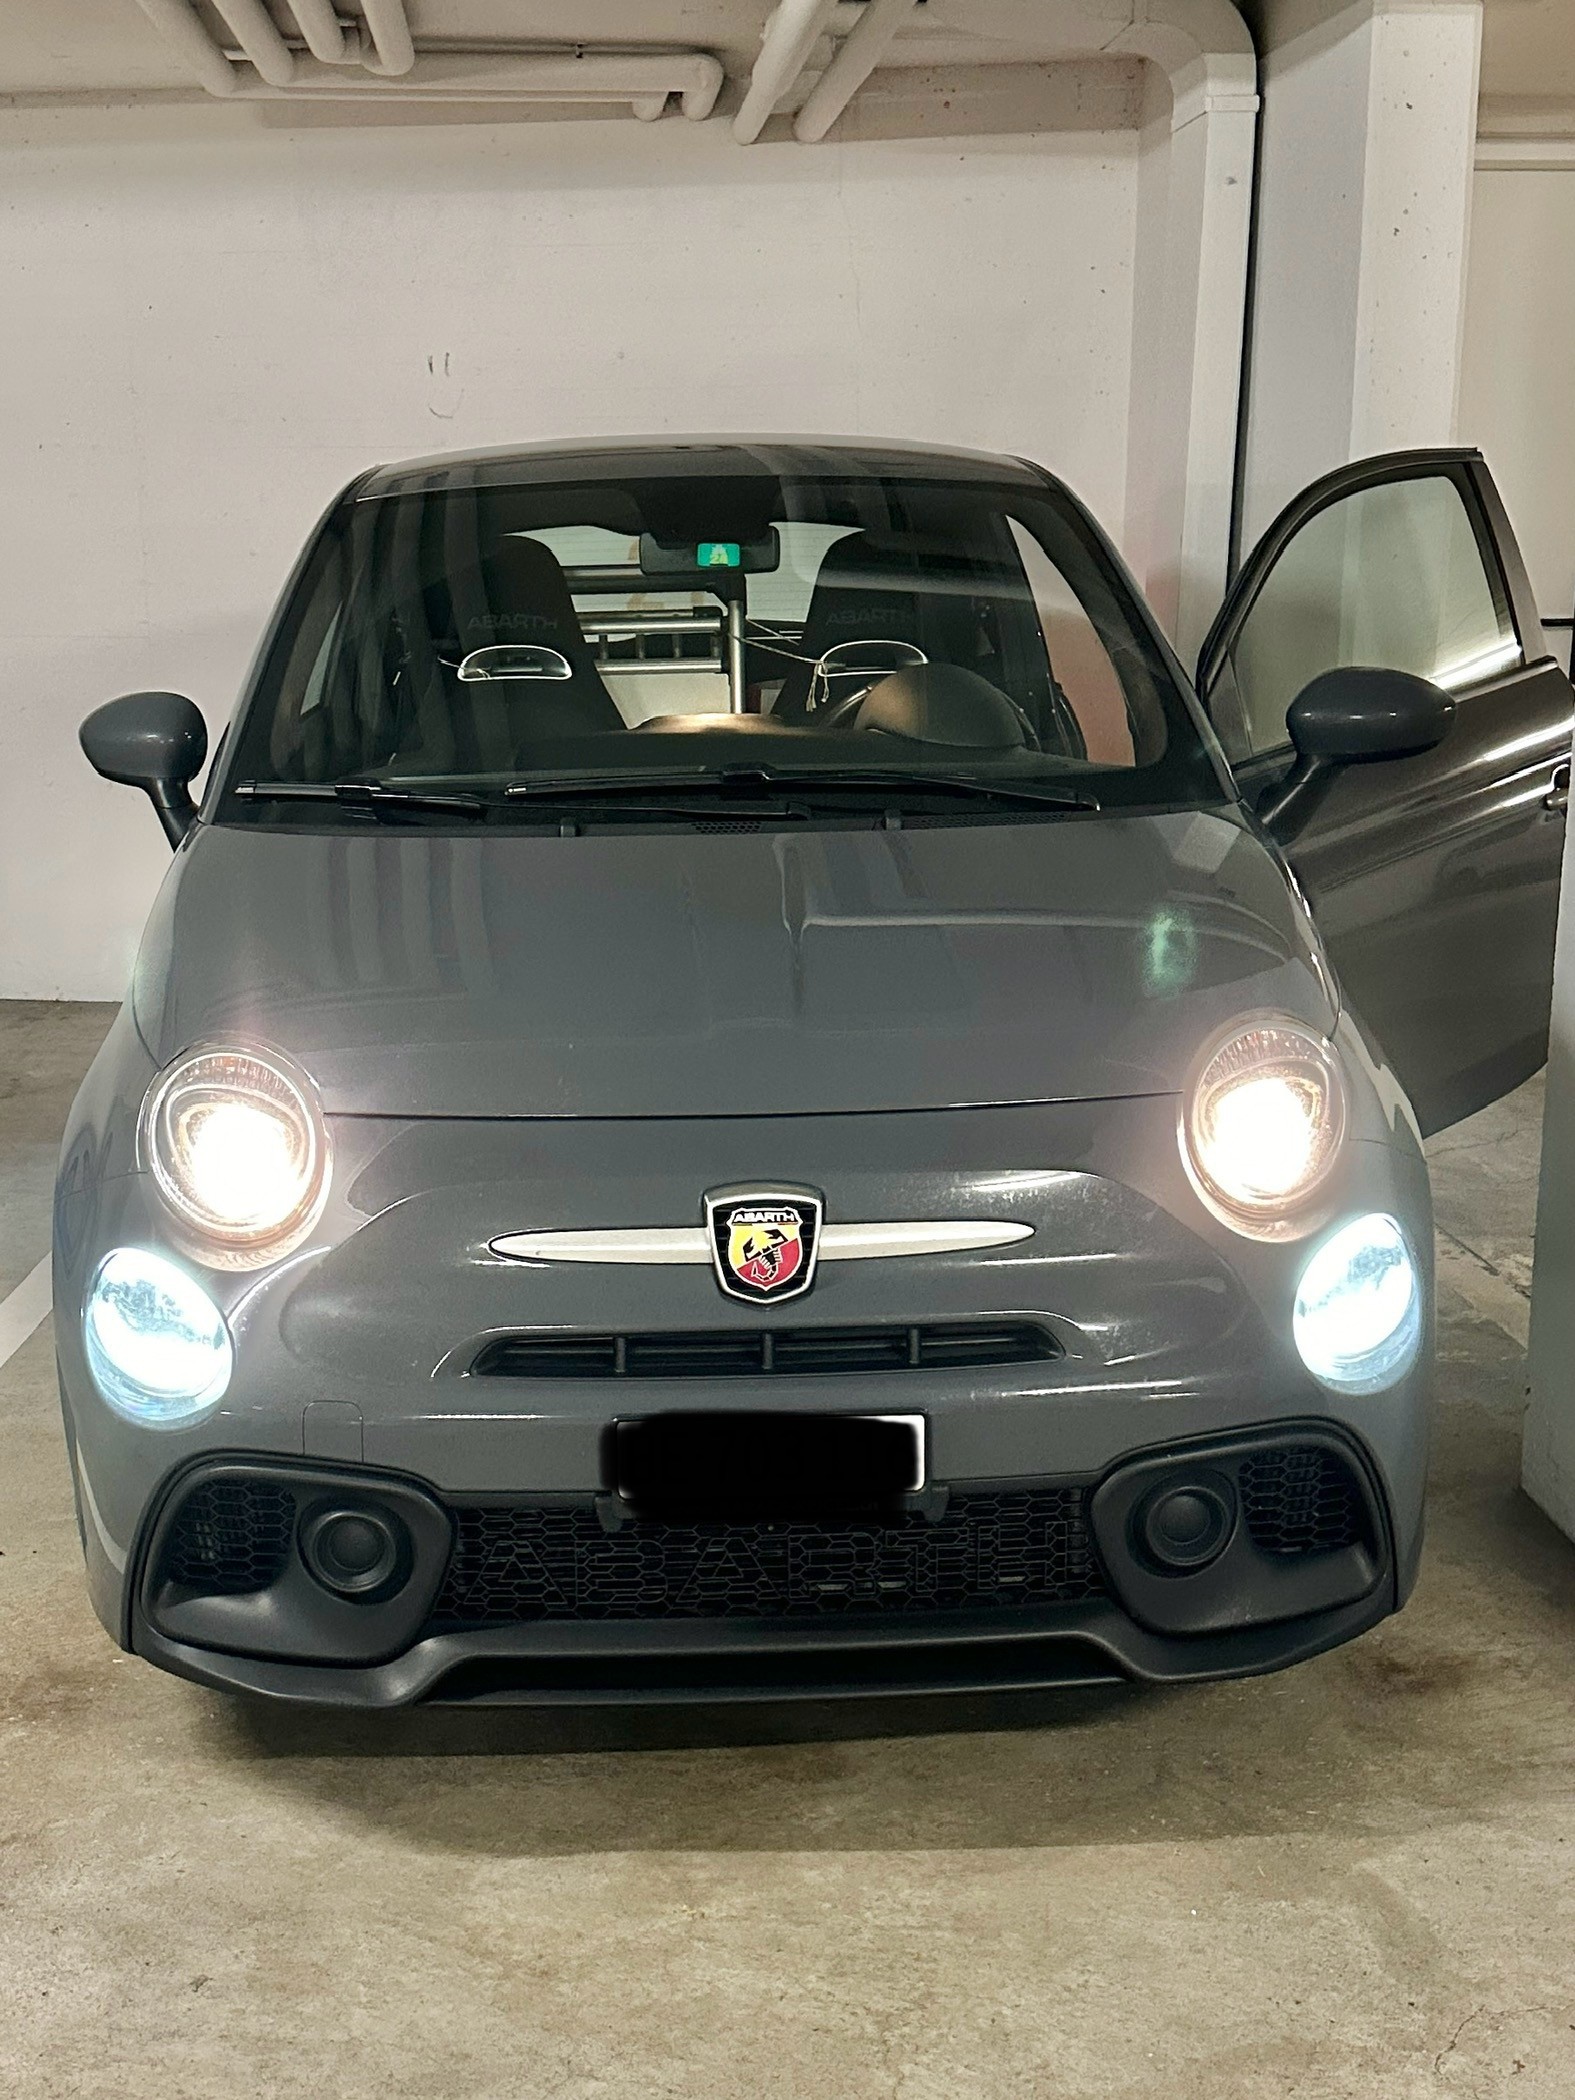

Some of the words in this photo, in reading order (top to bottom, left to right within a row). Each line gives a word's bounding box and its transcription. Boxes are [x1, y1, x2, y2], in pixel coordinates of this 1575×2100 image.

[467, 613, 558, 631] ABARTH
[733, 1210, 796, 1223] ABARTH
[463, 1519, 1072, 1606] ABARTH
